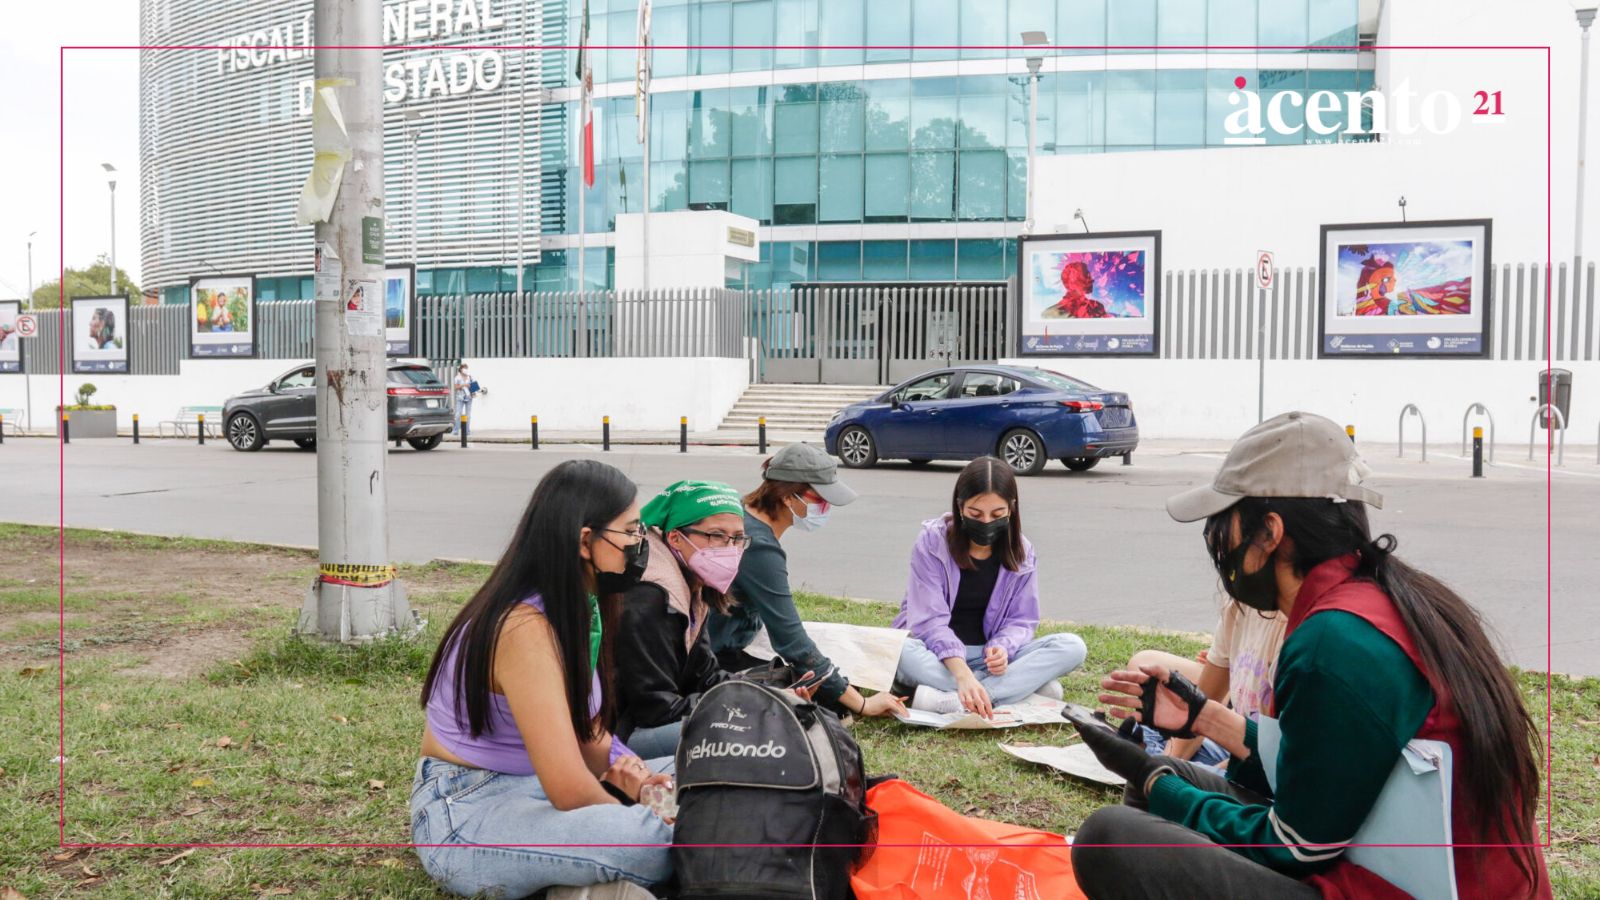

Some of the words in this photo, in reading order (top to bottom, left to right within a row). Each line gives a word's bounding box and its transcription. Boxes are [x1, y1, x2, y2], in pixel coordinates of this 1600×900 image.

[218, 10, 314, 74] FISCALÍ
[383, 0, 503, 44] NERAL
[384, 50, 503, 102] STADO
